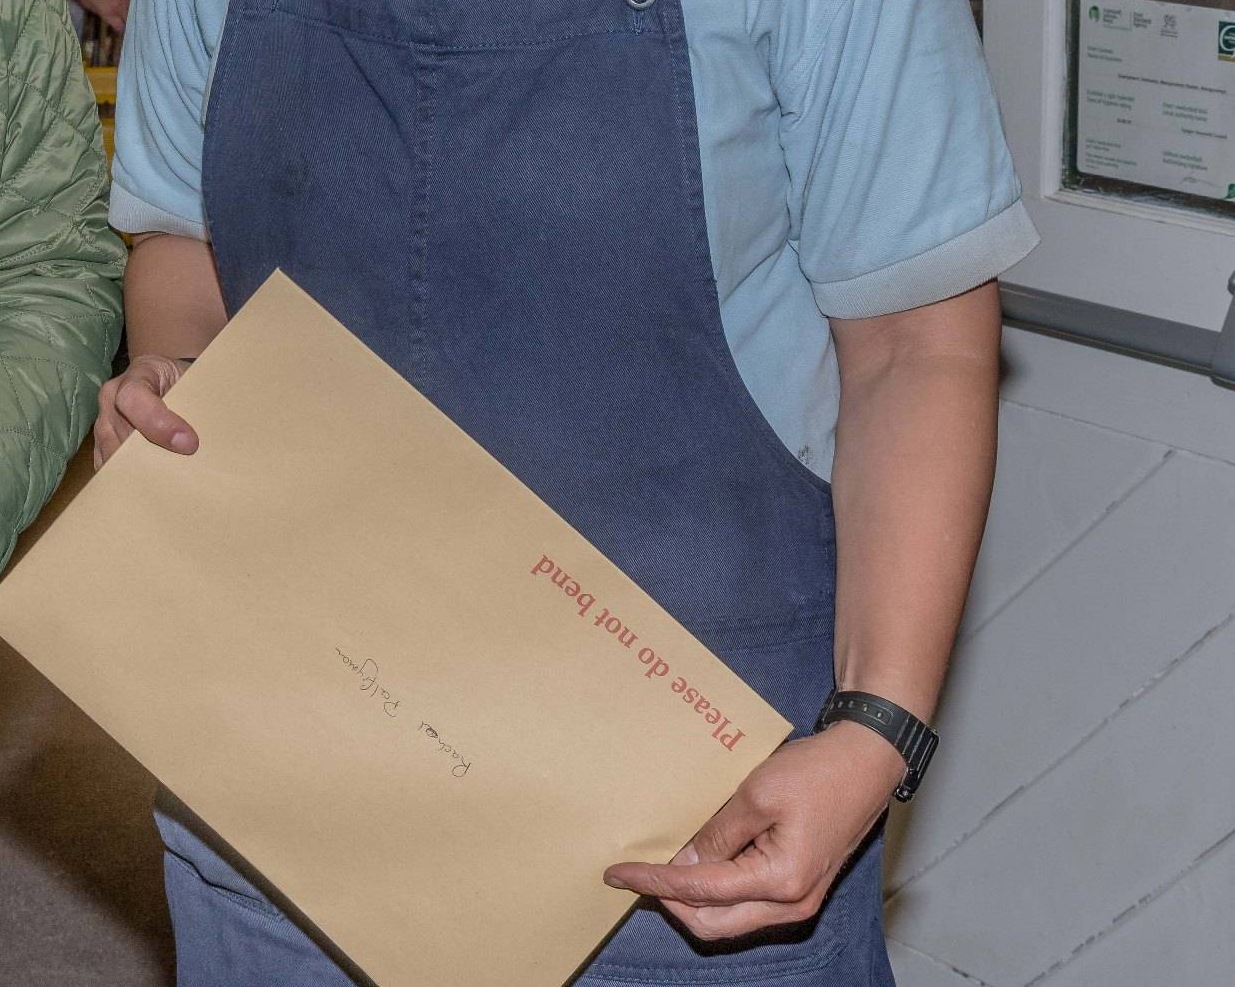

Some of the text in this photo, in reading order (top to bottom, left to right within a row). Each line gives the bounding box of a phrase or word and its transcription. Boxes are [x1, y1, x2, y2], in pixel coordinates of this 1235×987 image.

[530, 554, 746, 752] Please do not bend
